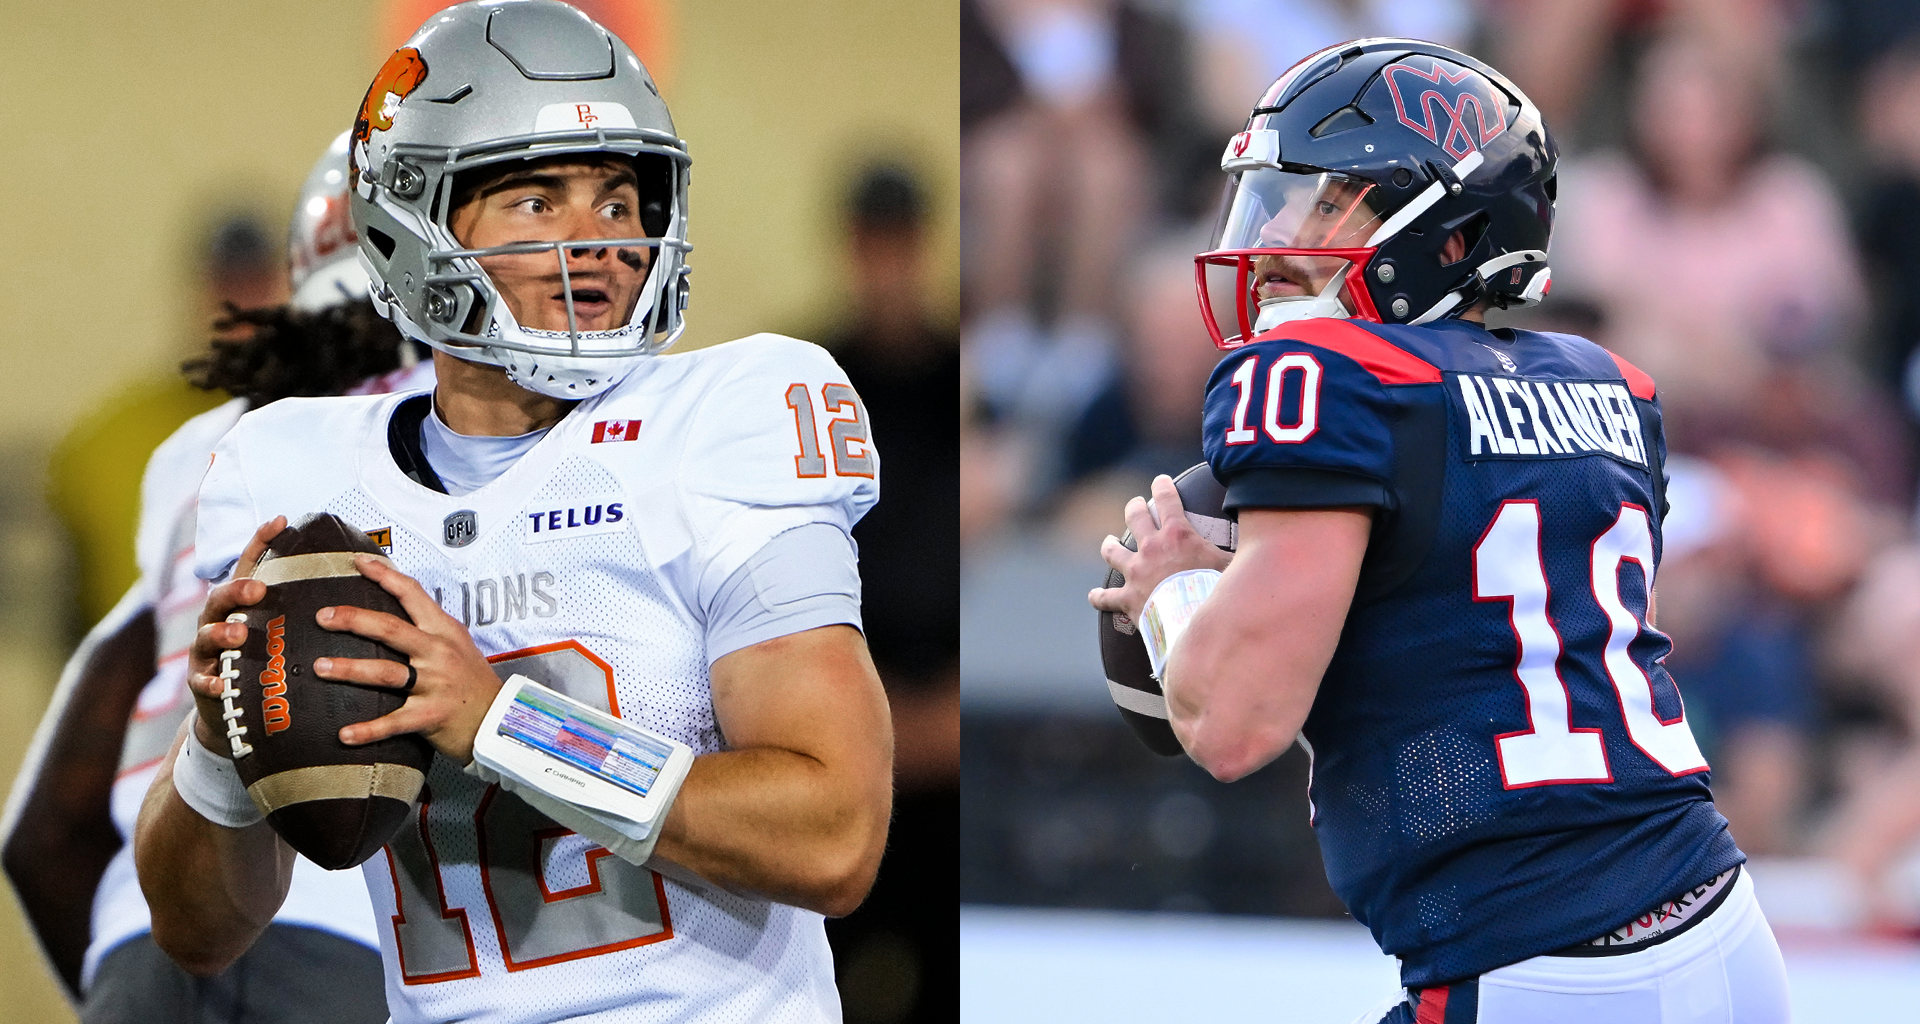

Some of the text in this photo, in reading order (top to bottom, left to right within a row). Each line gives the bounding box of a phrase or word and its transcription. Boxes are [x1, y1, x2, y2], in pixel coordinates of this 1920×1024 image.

[1510, 267, 1523, 285] 10
[784, 382, 875, 480] 12
[1225, 351, 1324, 447] 10
[1457, 374, 1648, 467] ALEXANDER
[529, 503, 624, 533] TELUS
[259, 614, 291, 737] Wilson
[1472, 498, 1710, 790] 10
